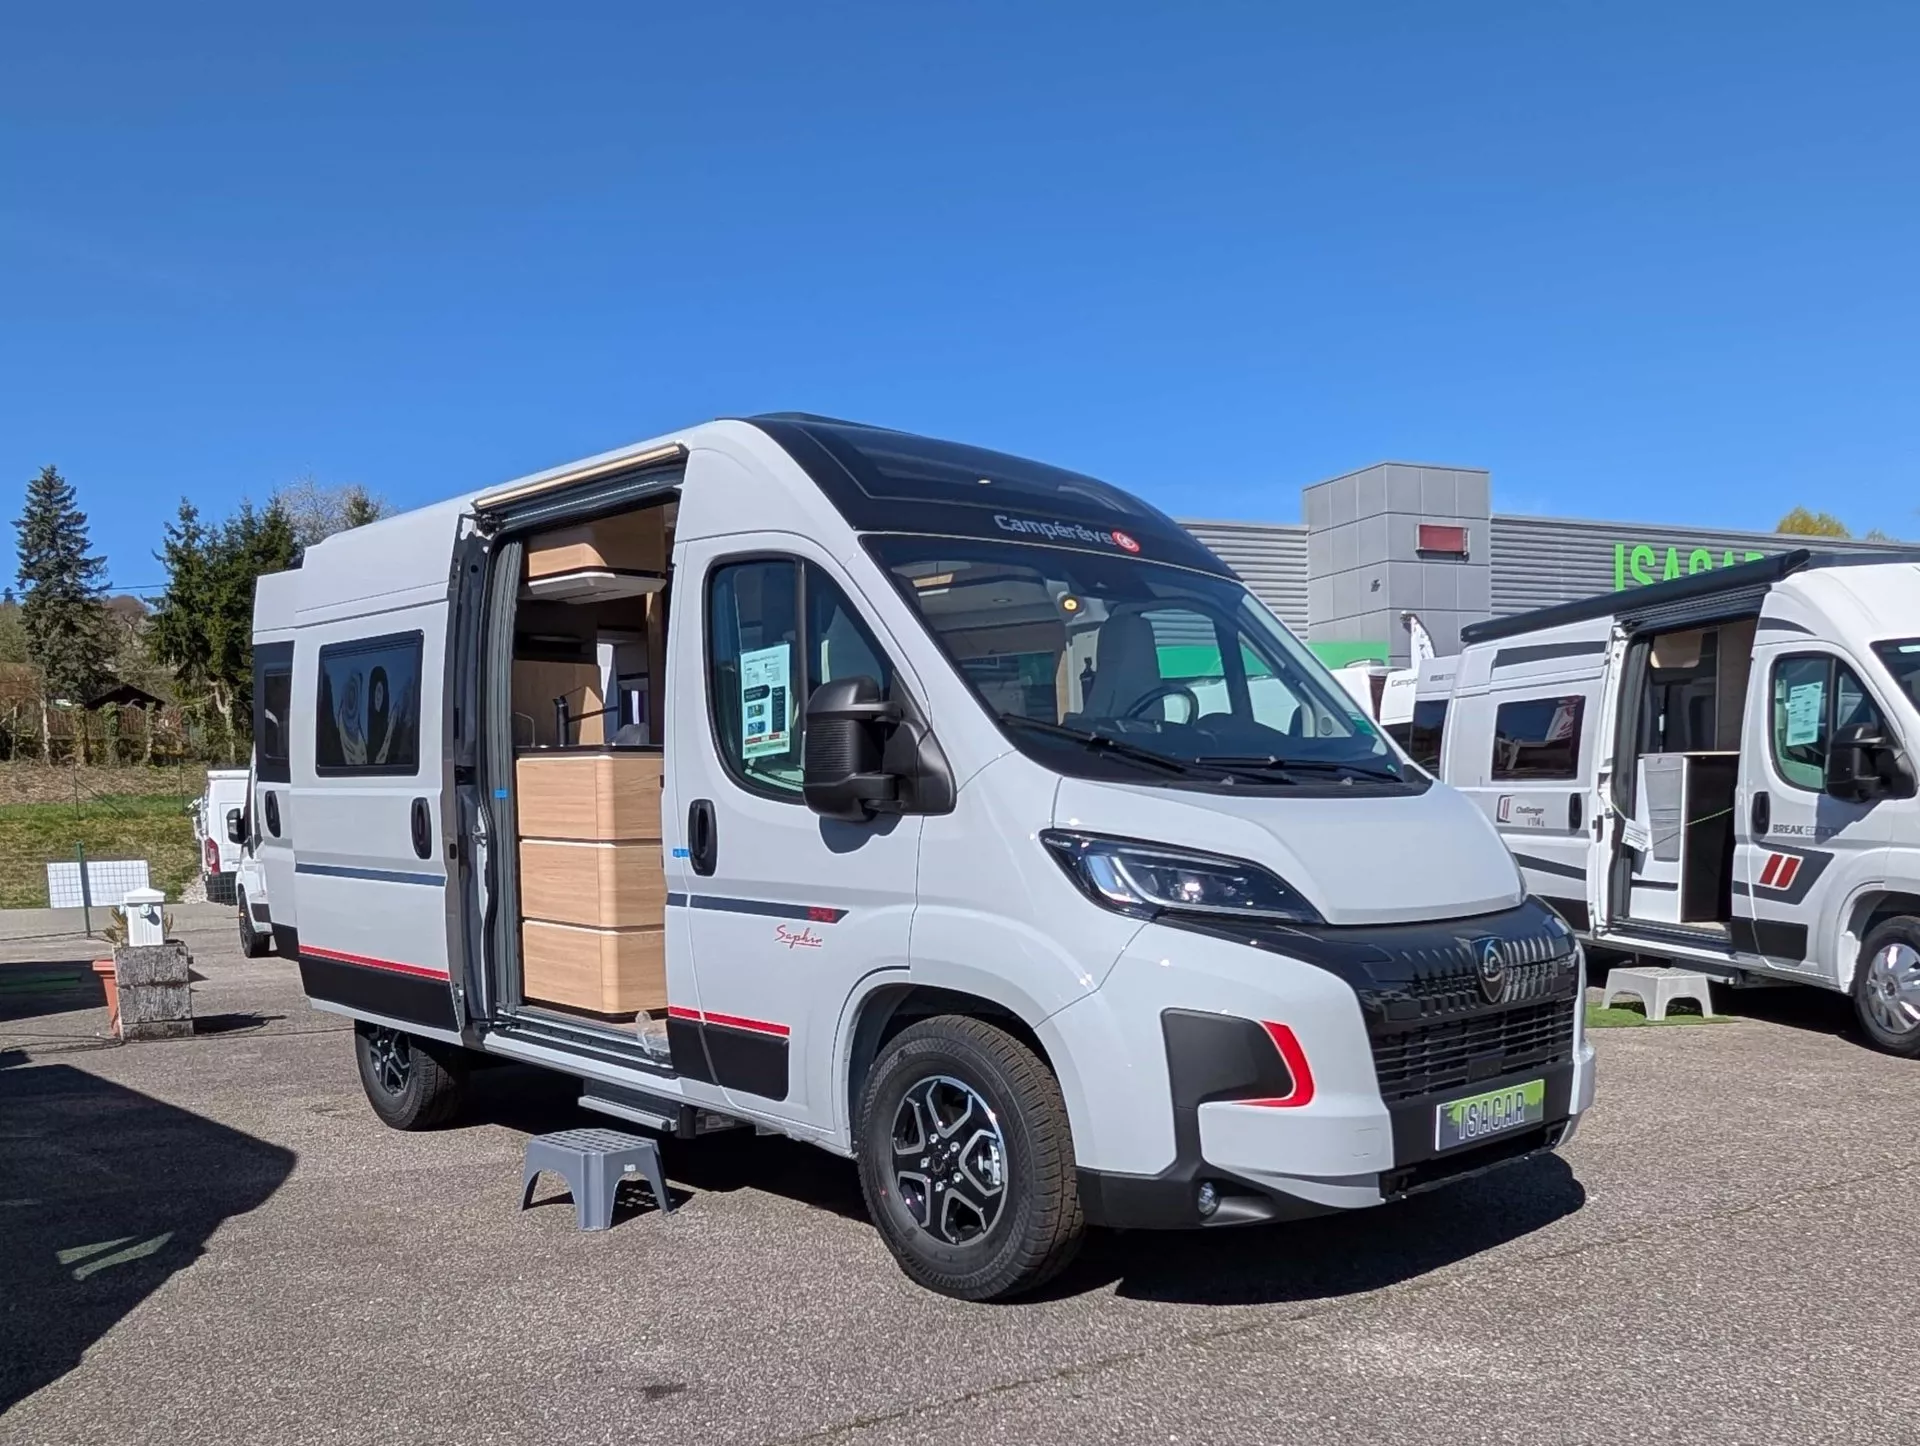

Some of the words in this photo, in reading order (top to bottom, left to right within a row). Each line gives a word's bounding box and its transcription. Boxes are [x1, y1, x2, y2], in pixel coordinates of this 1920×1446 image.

[1614, 543, 1765, 592] ISA
[1773, 824, 1804, 834] BREAK
[1459, 1090, 1525, 1140] ISACAR
